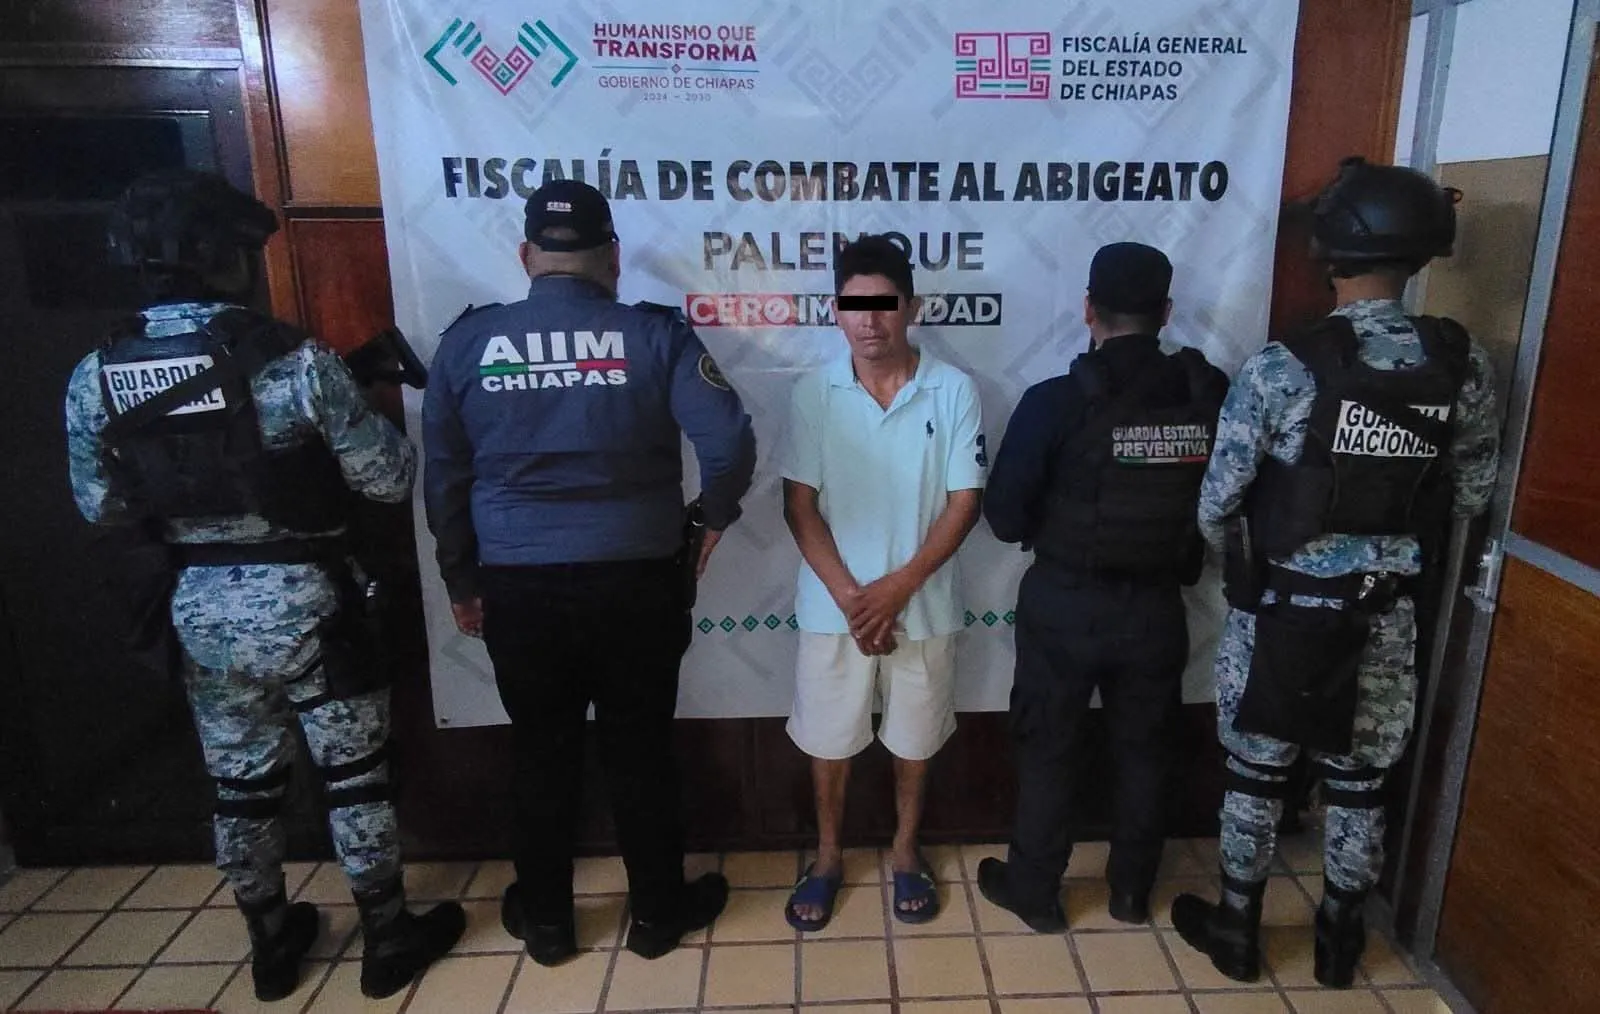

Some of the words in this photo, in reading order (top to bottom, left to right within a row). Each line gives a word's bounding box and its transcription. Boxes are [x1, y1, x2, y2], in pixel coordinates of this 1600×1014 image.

[594, 23, 712, 41] HUMANISMO
[717, 25, 756, 43] QUE
[1062, 32, 1151, 53] FISCALÍA
[1157, 37, 1247, 54] GENERAL
[593, 39, 757, 62] TRANSFORMA
[1062, 59, 1099, 76] DEL
[1105, 60, 1182, 77] ESTADO
[598, 75, 669, 89] GOBIERNO
[673, 76, 692, 89] DE
[695, 77, 755, 90] CHIAPAS
[1060, 84, 1086, 100] DE
[1091, 84, 1178, 101] CHIAPAS
[657, 160, 714, 201] DE
[726, 160, 940, 202] COMBATE
[949, 161, 1005, 202] AL
[1013, 160, 1229, 202] ABIGEATO
[690, 296, 791, 325] CERO
[798, 295, 1000, 325] IMDAD
[480, 331, 625, 366] AIIM
[481, 369, 628, 392] CHIAPAS
[1112, 426, 1160, 441] GUARDIA
[1162, 425, 1209, 440] ESTATAL
[1113, 441, 1208, 457] PREVENTIVA
